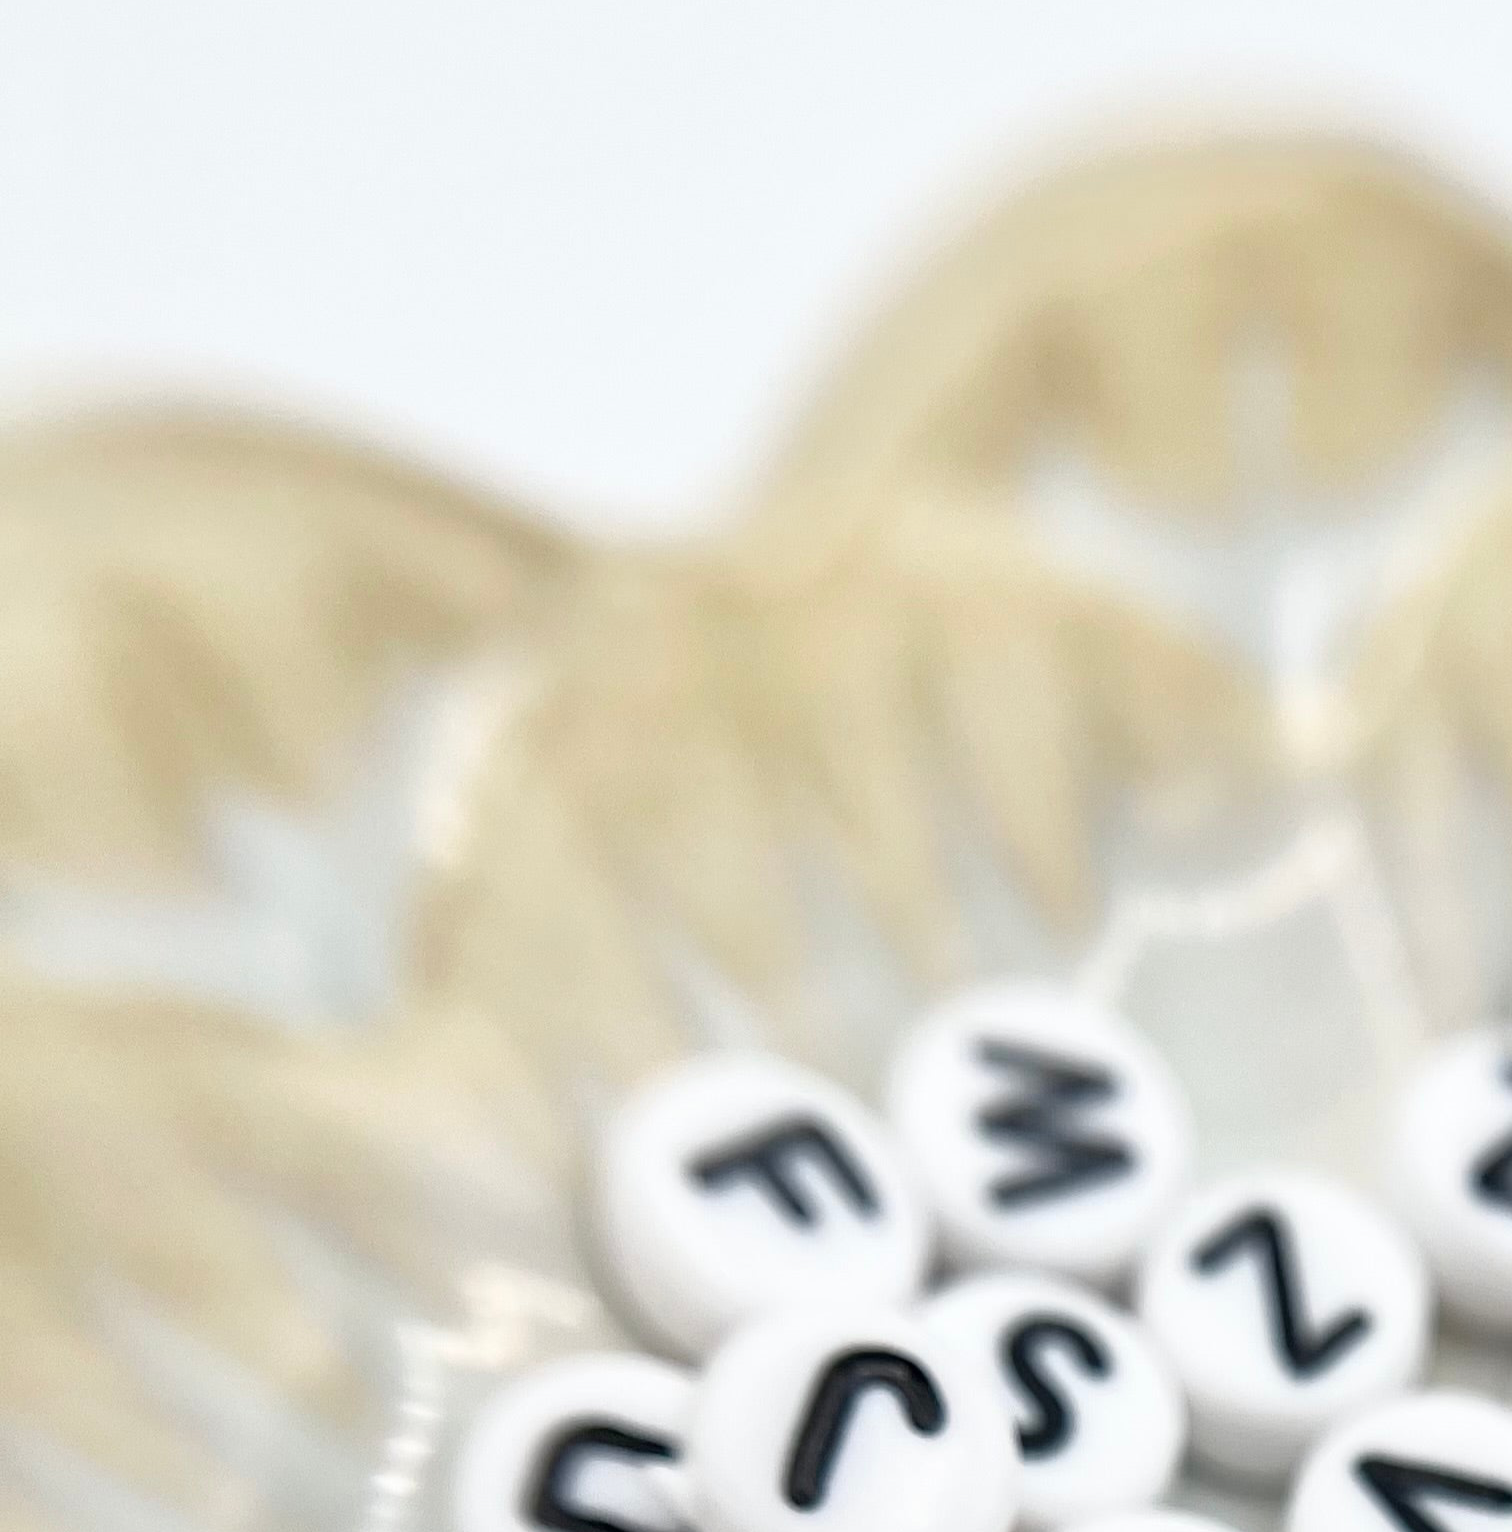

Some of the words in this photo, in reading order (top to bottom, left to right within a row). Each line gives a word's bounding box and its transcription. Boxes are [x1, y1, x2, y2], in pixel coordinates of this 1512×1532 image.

[688, 1115, 879, 1227] F
[1192, 1207, 1370, 1380] Z
[780, 1343, 947, 1513] J
[1000, 1312, 1112, 1460] S
